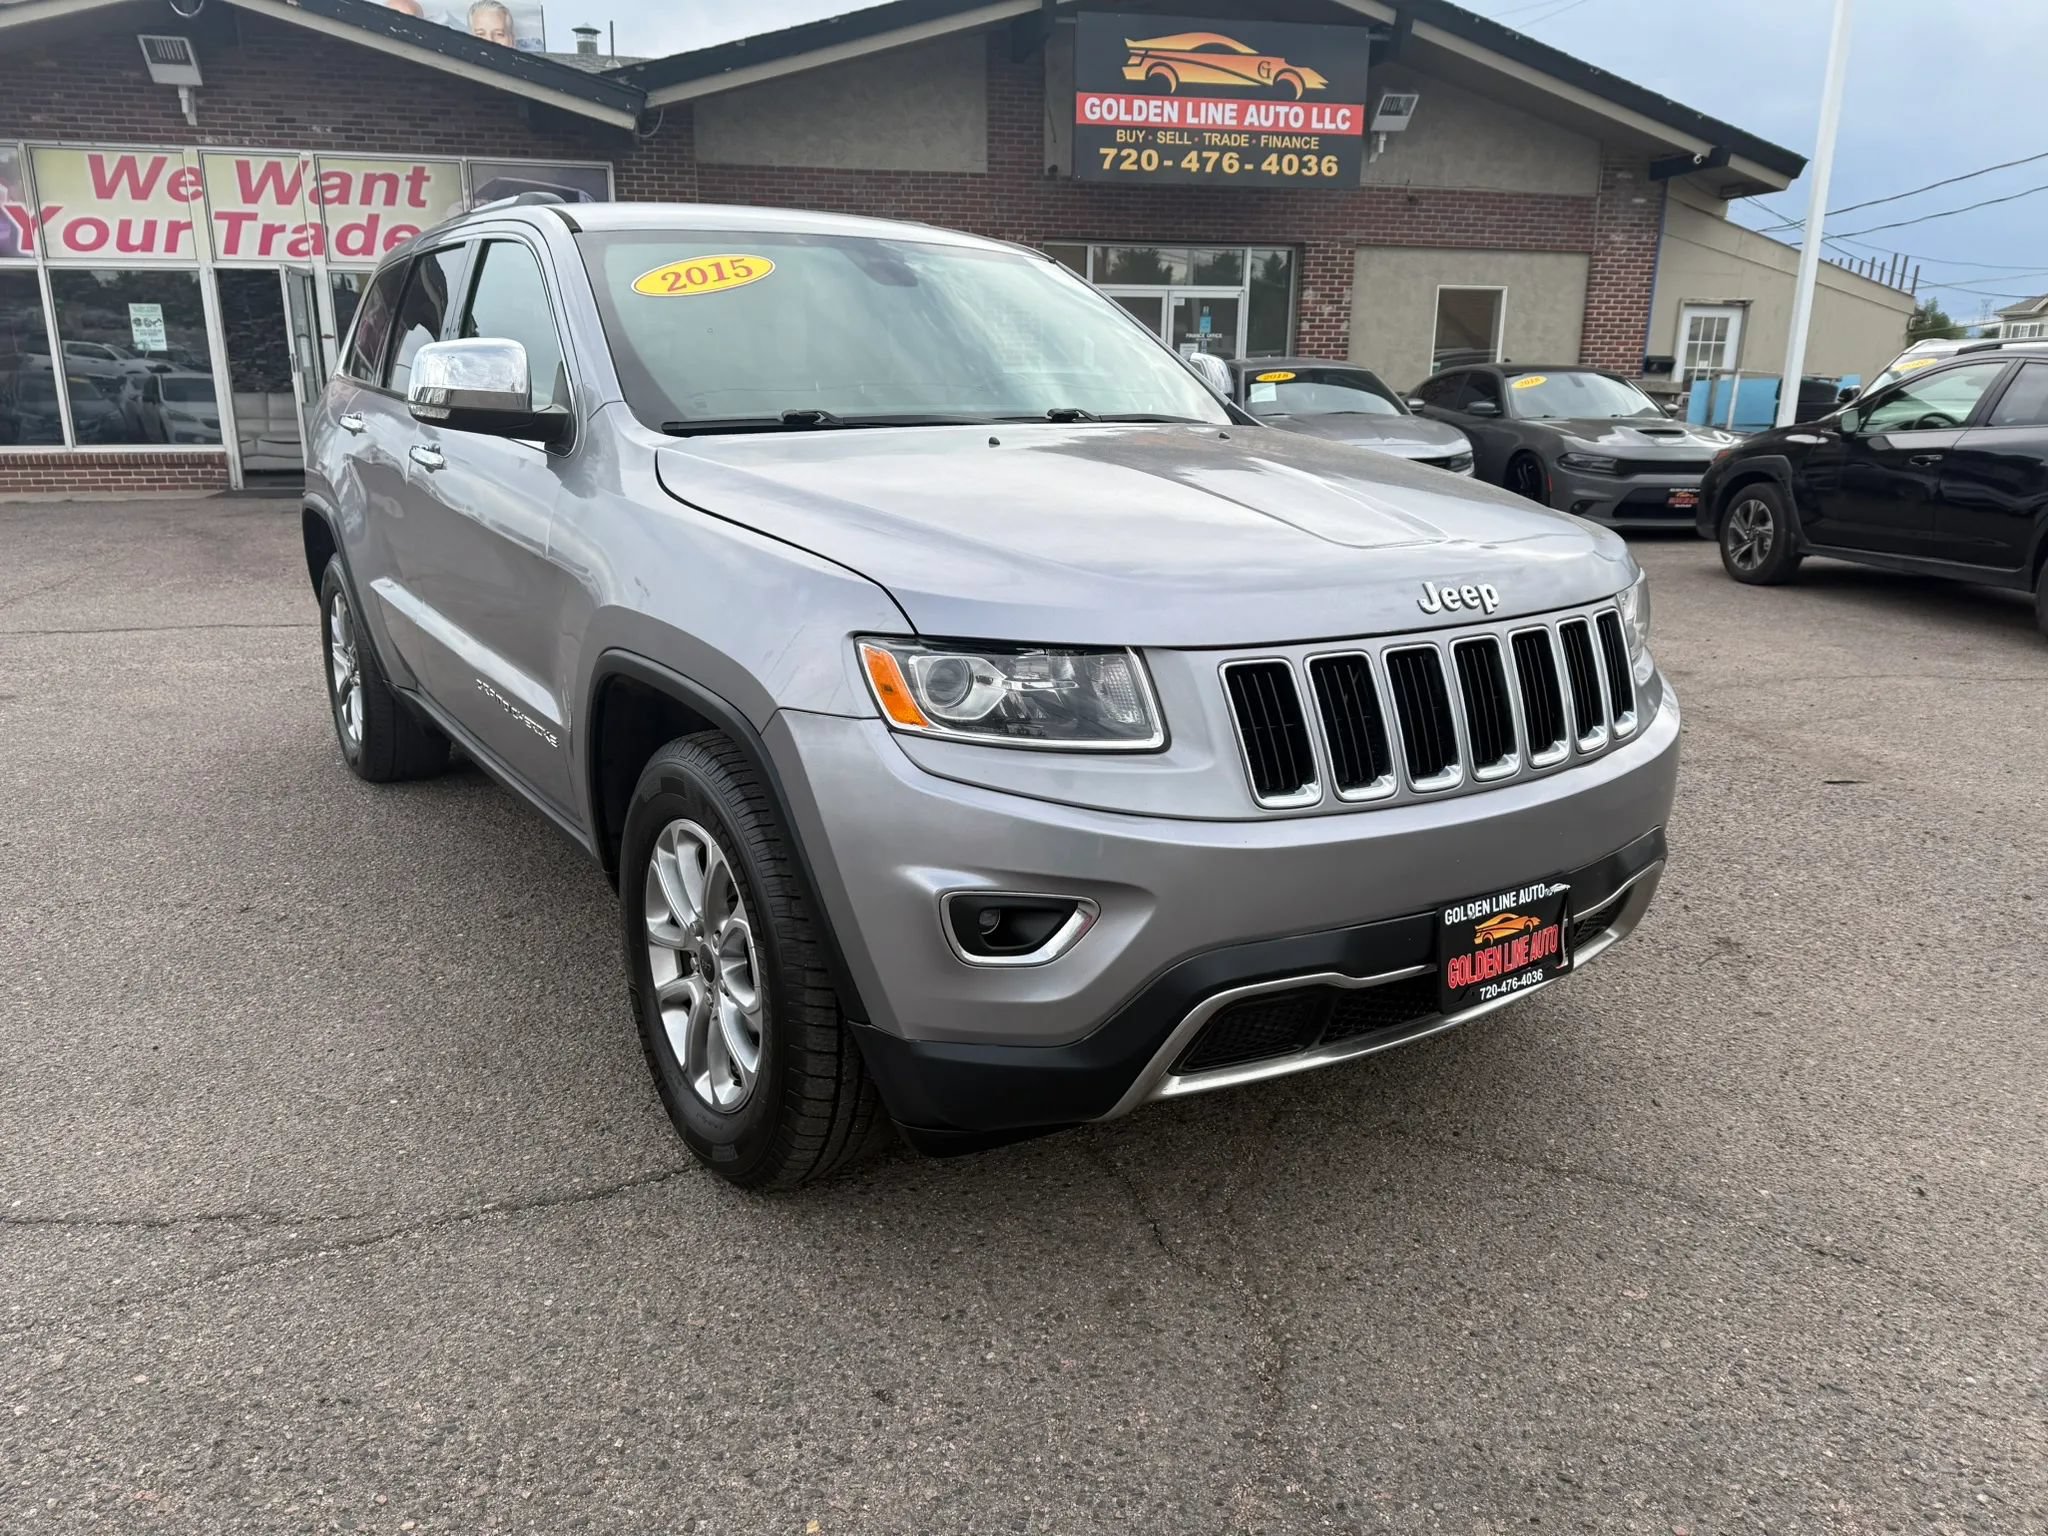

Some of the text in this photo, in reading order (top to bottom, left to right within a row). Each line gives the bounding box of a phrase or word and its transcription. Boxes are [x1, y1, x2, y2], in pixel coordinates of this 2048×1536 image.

[1084, 97, 1351, 130] GOLDEN LINE AUTO LLC
[1116, 129, 1320, 150] BUY SELL TRADE FINANCE
[1099, 147, 1339, 177] 720-476-4036
[87, 154, 432, 209] We Want
[3, 205, 423, 259] Your Trade
[660, 258, 753, 292] 2015
[1416, 581, 1500, 615] Jeep
[1444, 883, 1546, 925] GOLDEN LINE AUTO
[1447, 923, 1559, 990] GOLDEN LINE AUTO
[1479, 968, 1544, 1001] 720-476-4036
